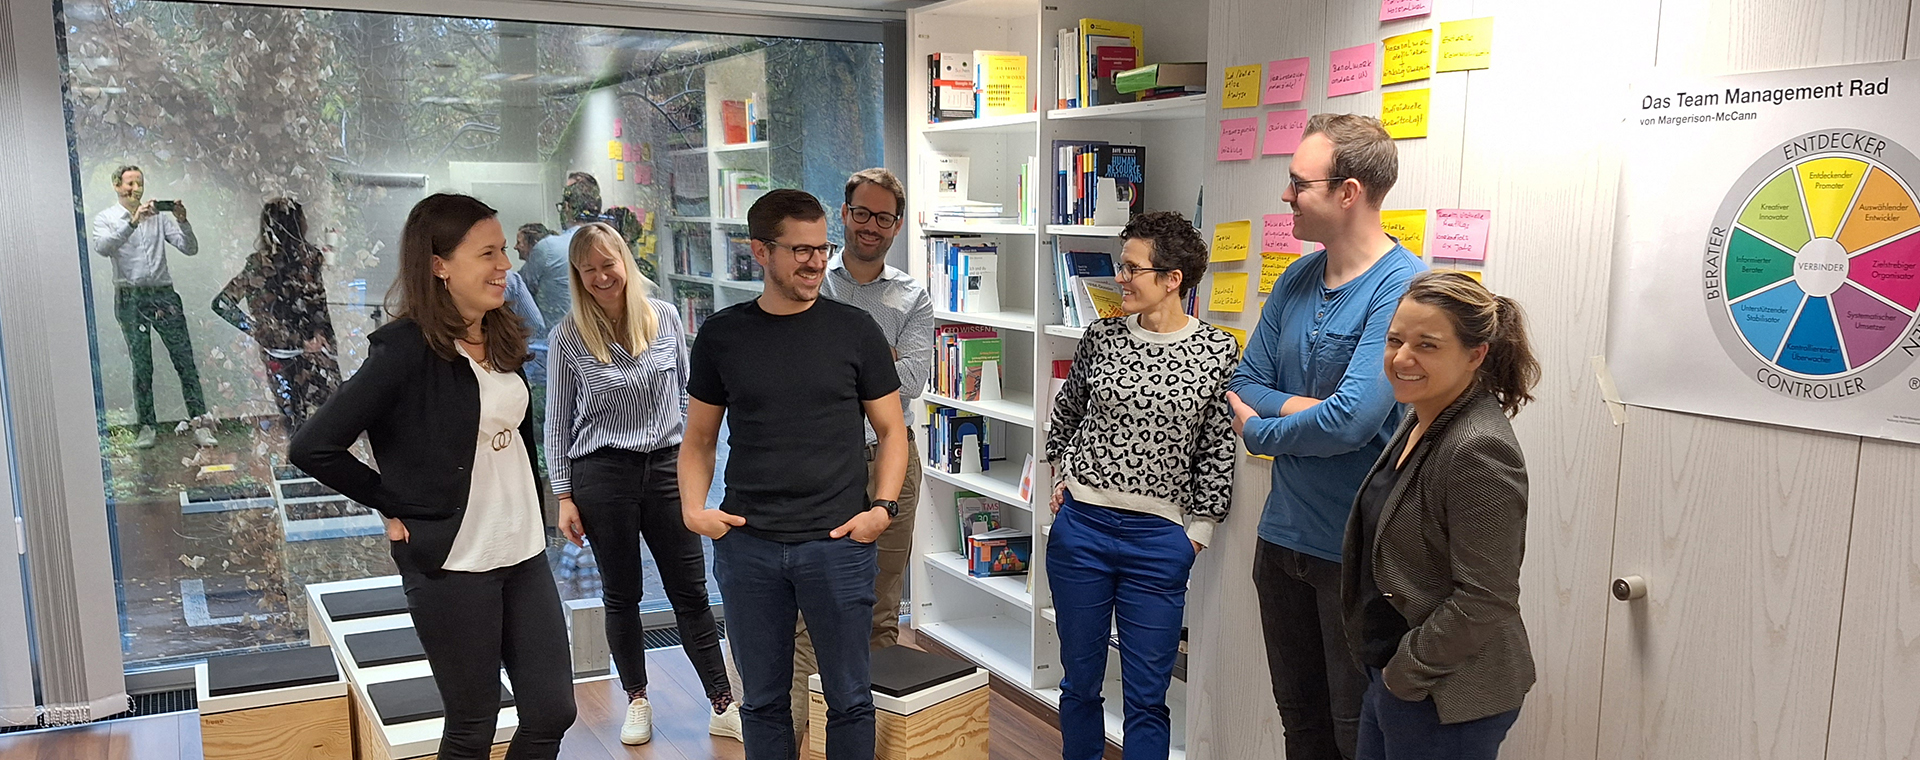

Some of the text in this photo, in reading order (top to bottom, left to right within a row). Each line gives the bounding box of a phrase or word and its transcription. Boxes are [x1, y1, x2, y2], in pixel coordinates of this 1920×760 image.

[1641, 78, 1889, 110] Das Team Management Rad
[1640, 111, 1757, 126] von Margerison-McCann
[1783, 132, 1887, 160] ENTDECKER
[1112, 156, 1136, 165] HUMAN
[1107, 165, 1140, 174] RESOURCE
[1809, 171, 1853, 180] Entdeckender
[1815, 182, 1845, 190] Promoter
[1760, 203, 1790, 211] Kreativer
[1858, 203, 1909, 212] Auswählender
[1865, 213, 1900, 222] Entwickler
[1705, 226, 1726, 300] BERATER
[1736, 256, 1771, 265] Informierter
[1872, 260, 1917, 270] Zielstrebiger
[1798, 262, 1844, 272] VERBINDER
[1872, 271, 1915, 281] Organisator
[1741, 304, 1789, 314] Unterstützender
[1746, 314, 1780, 324] Stabilisator
[1847, 311, 1897, 321] Systematischer
[1855, 322, 1886, 331] Umsetzer
[1787, 343, 1839, 354] Kontrollierender
[1792, 353, 1831, 364] Überwacher
[1756, 368, 1866, 400] CONTROLLER
